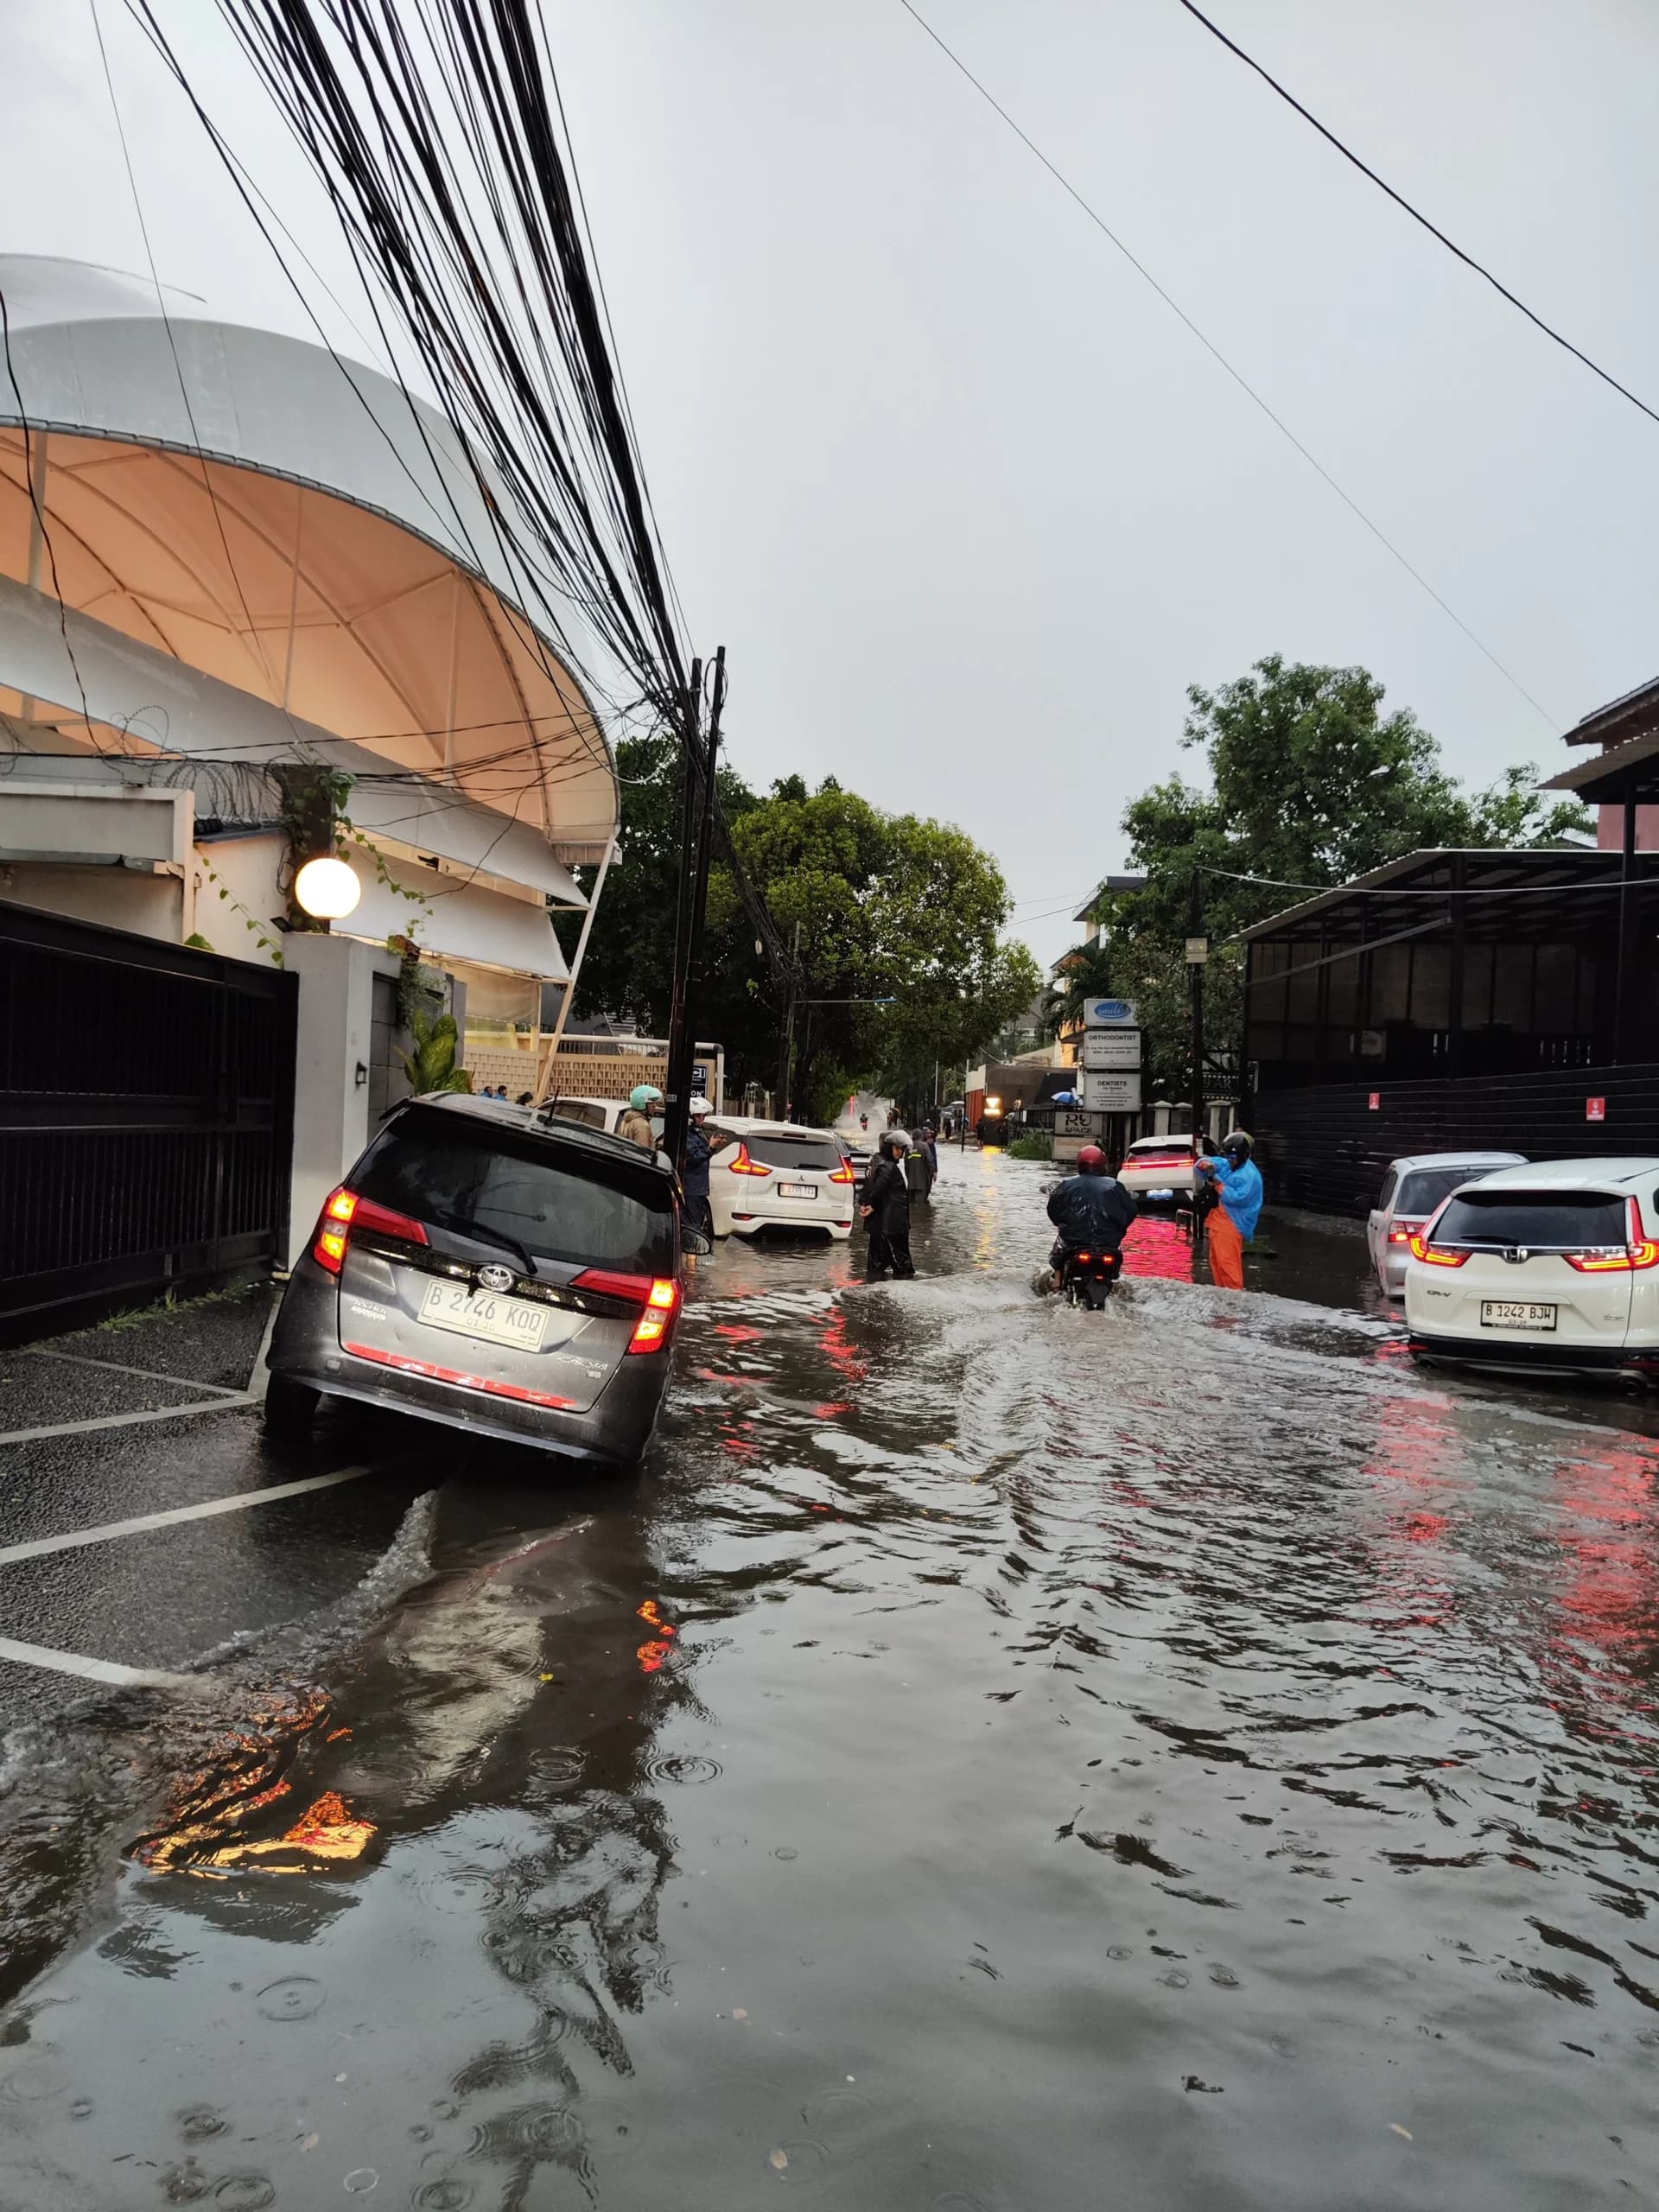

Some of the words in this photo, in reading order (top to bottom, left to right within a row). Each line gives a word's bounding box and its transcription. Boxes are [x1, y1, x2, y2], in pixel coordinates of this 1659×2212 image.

[429, 1286, 443, 1306] B
[448, 1292, 496, 1319] 2746
[1485, 1304, 1492, 1316] B
[1497, 1305, 1525, 1319] 1242
[1529, 1306, 1552, 1319] BJW
